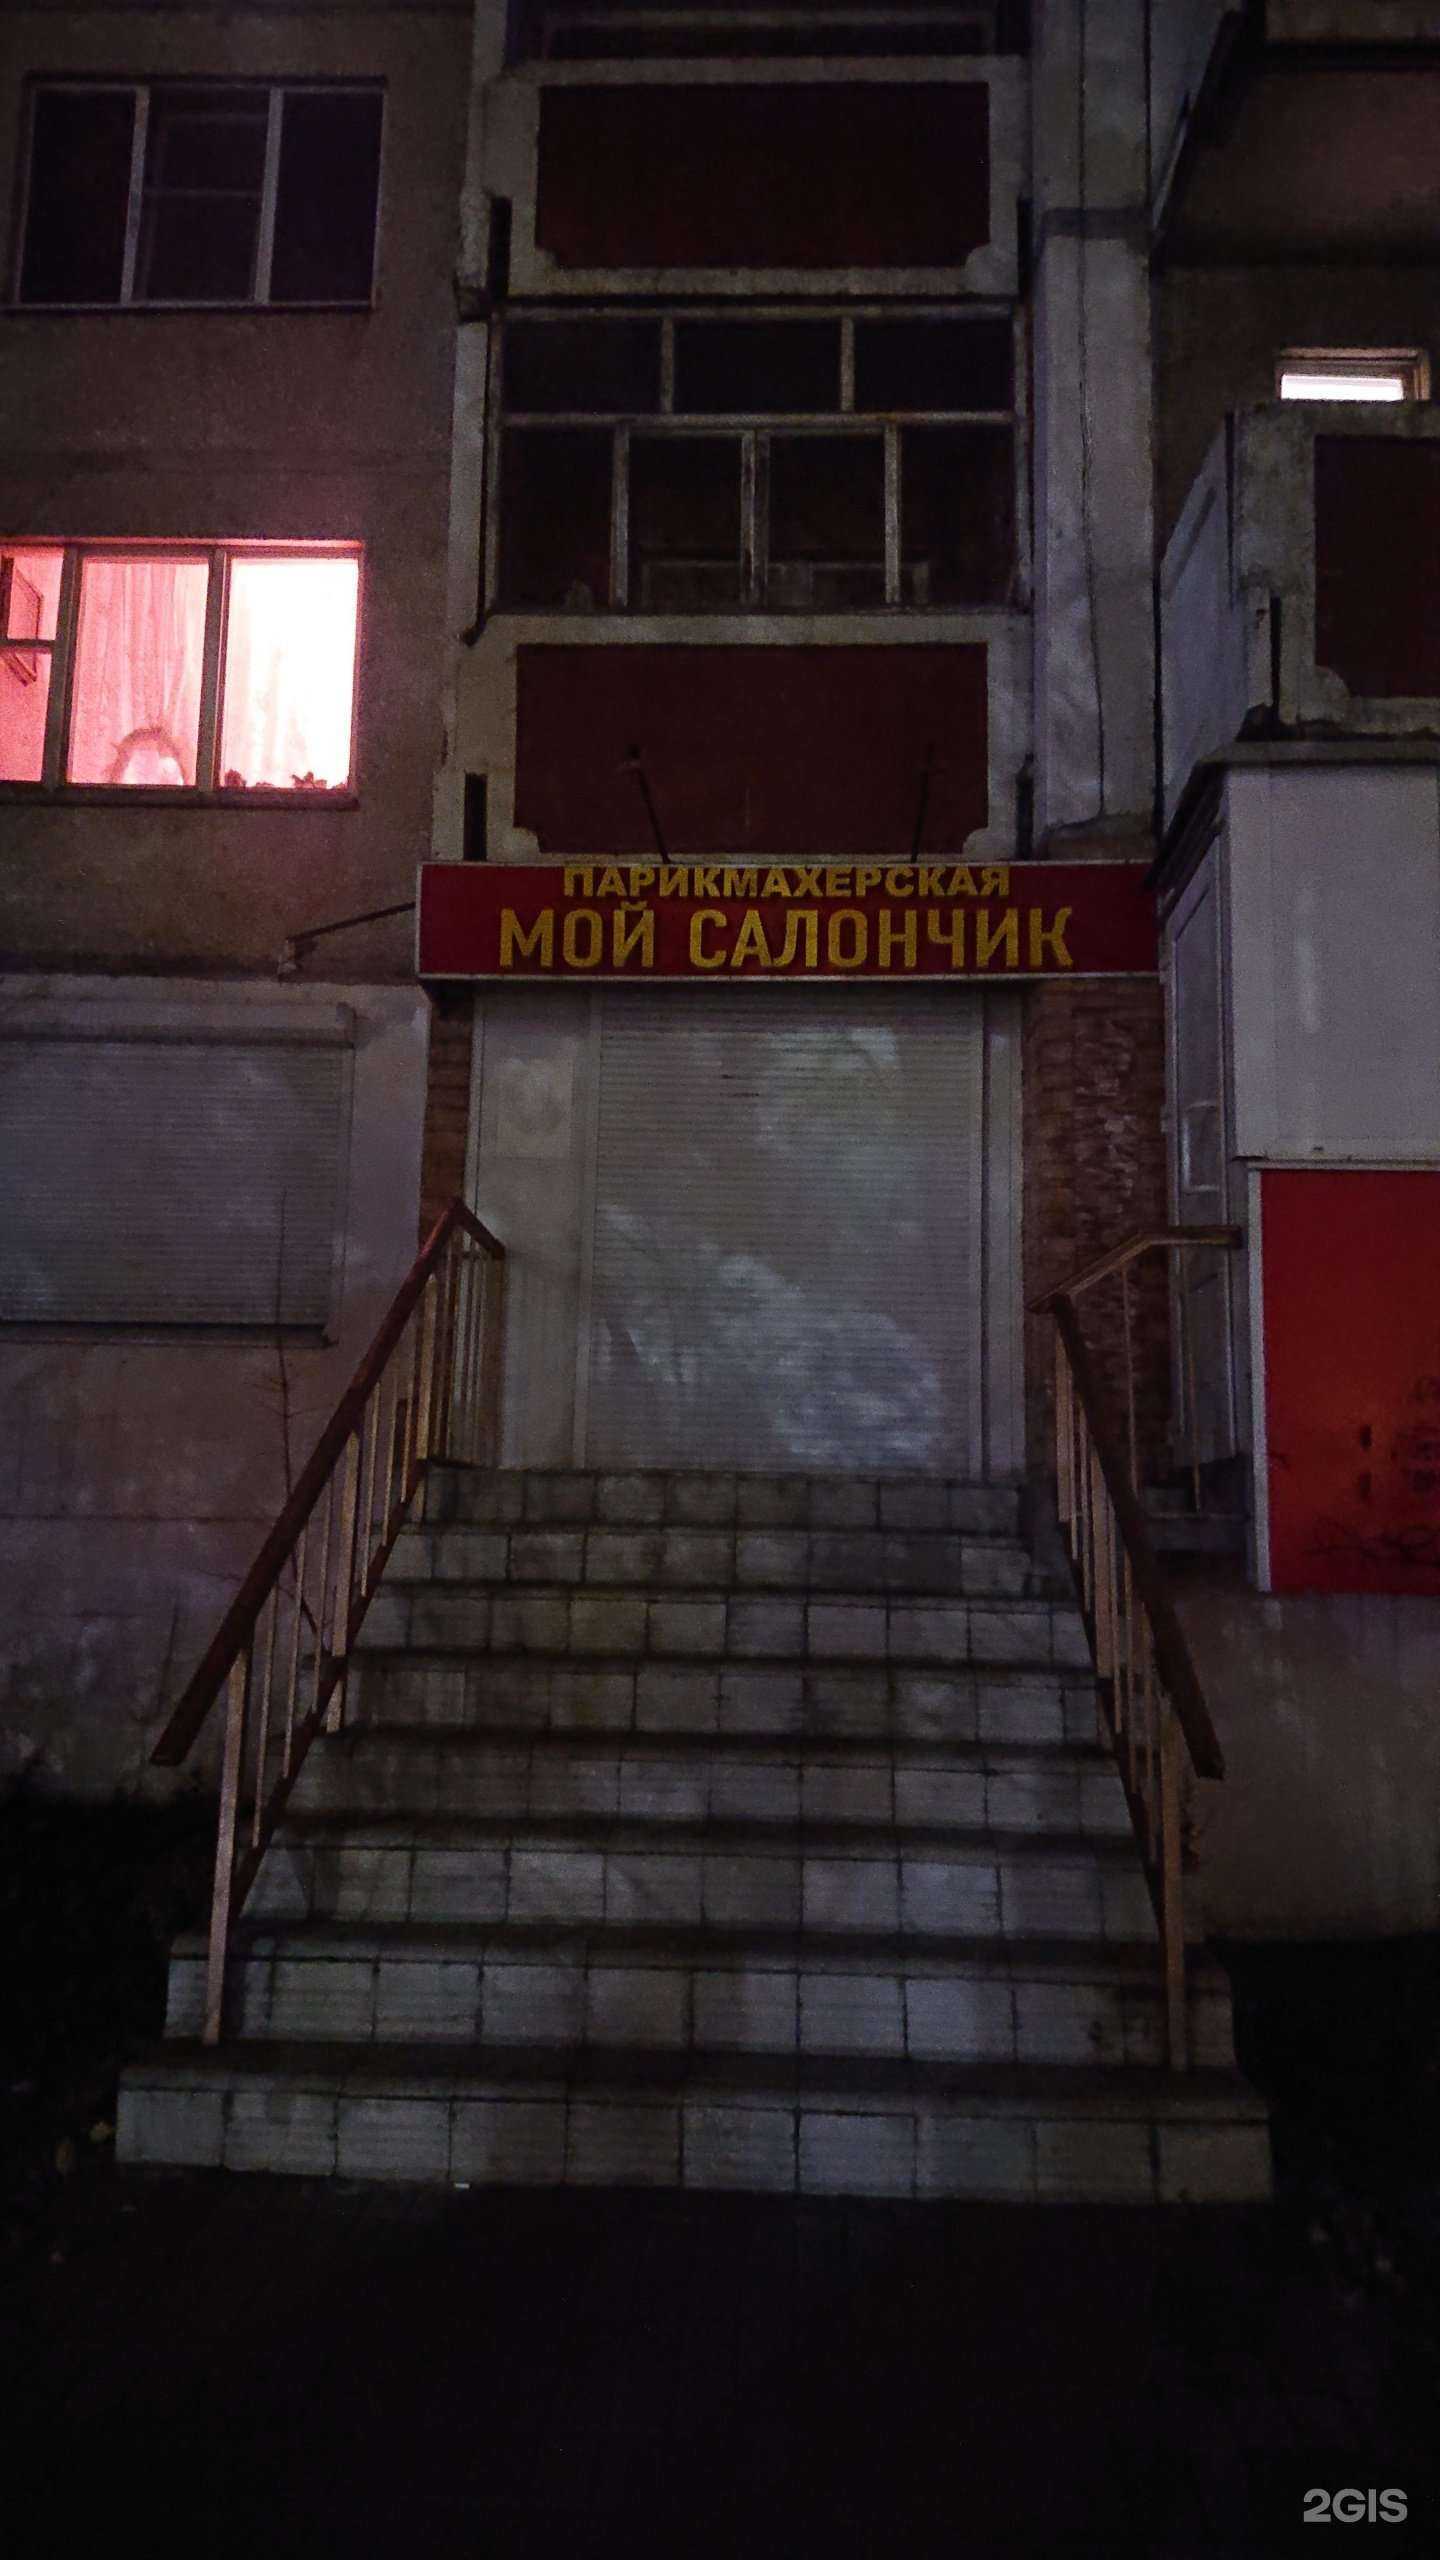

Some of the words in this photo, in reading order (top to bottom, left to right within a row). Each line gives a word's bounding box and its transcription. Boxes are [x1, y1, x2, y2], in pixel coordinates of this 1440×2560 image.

[563, 866, 1011, 898] ПАРИКМАХЕРСКАЯ
[499, 900, 654, 968] МОЙ
[688, 906, 1073, 969] САЛОНЧИК
